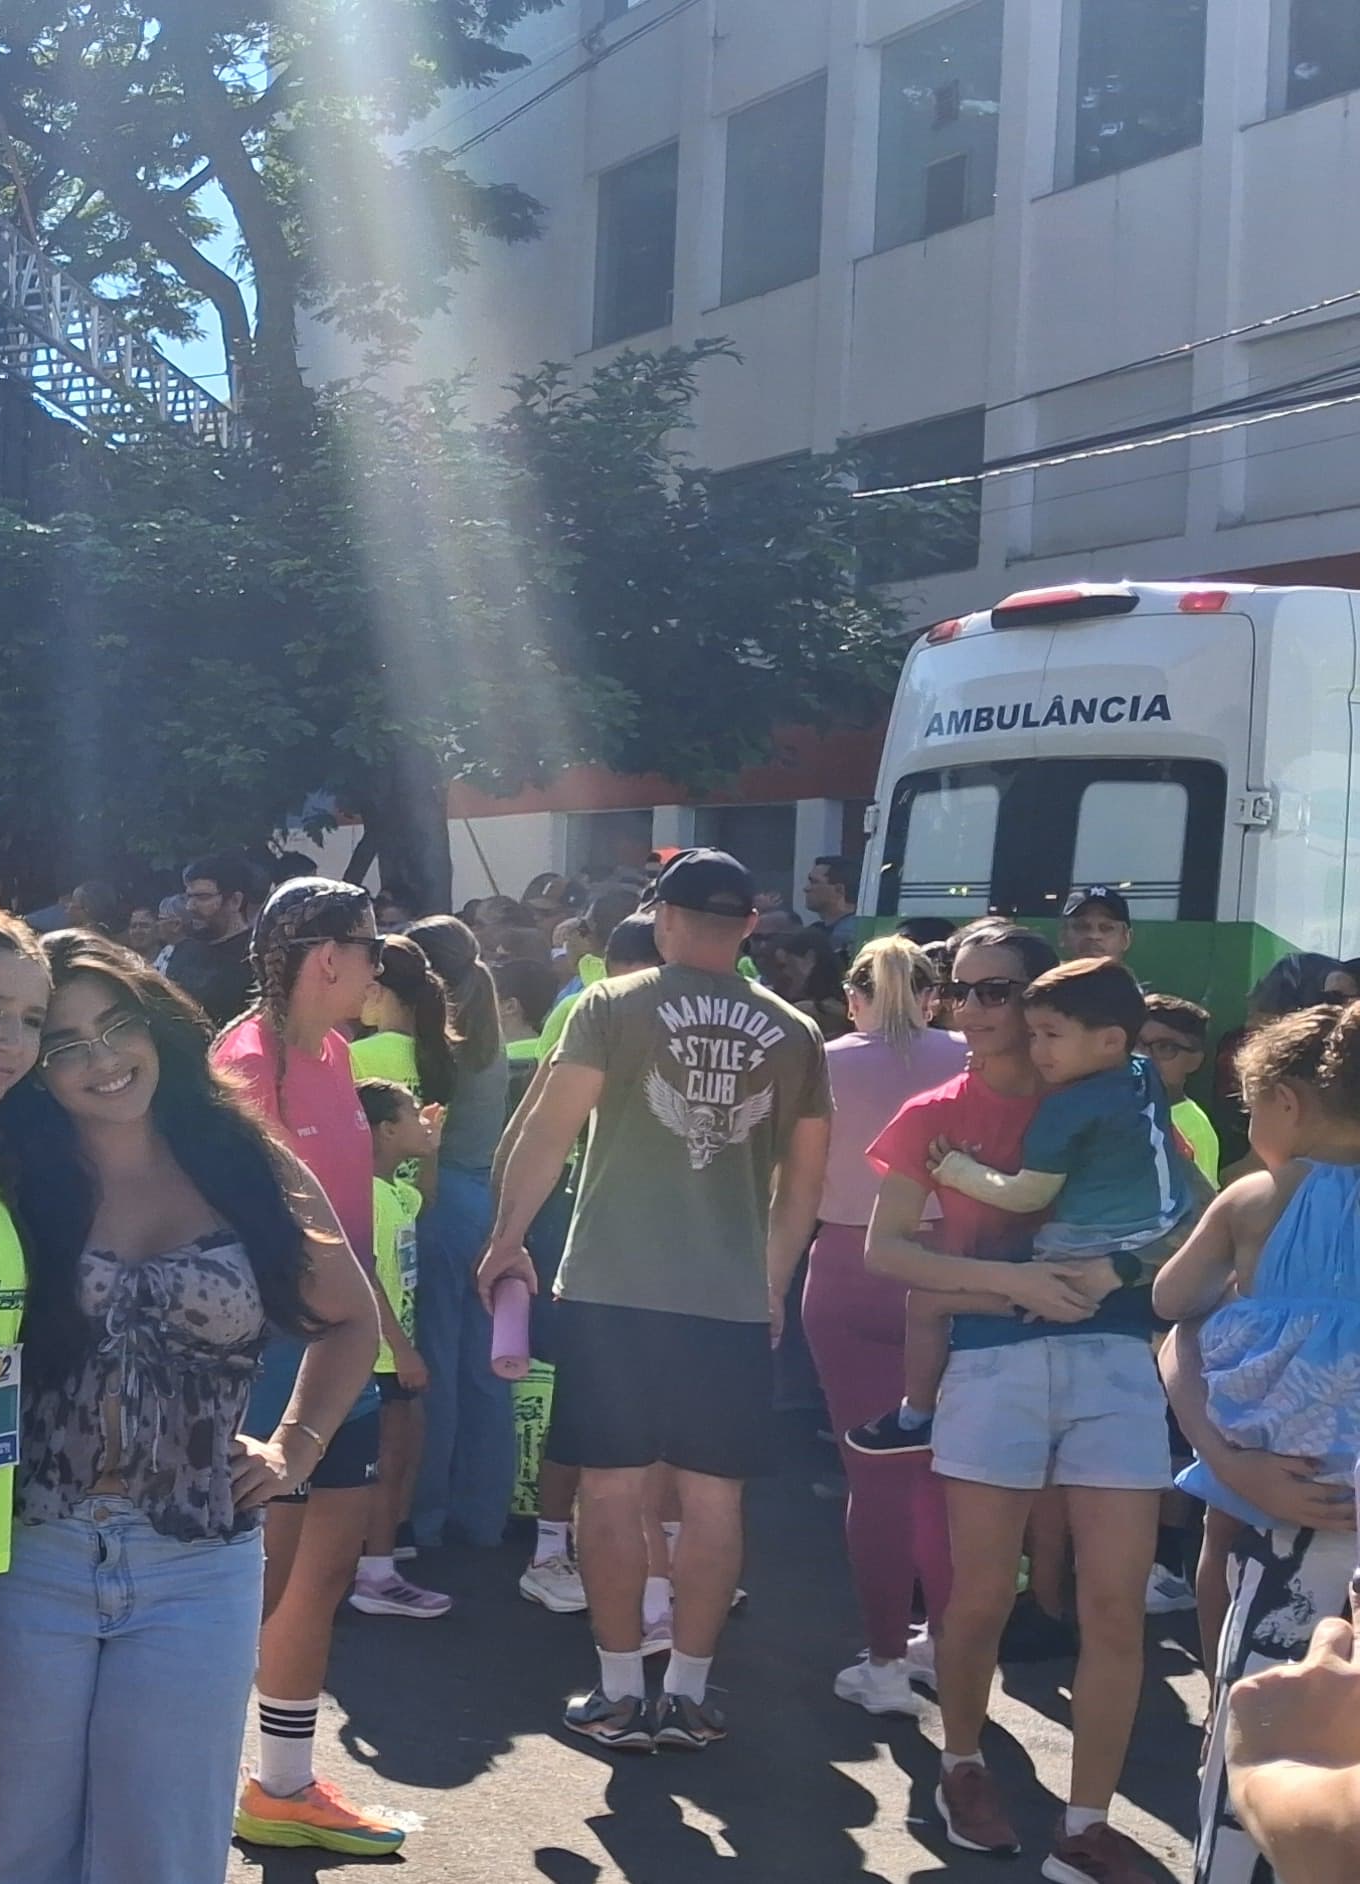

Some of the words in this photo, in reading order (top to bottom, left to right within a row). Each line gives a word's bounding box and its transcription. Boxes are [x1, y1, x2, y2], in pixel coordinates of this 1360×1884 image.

[924, 694, 1172, 738] AMBULÂNCIA
[657, 995, 786, 1049] MANHOOD
[685, 1035, 746, 1071] STYLE
[686, 1070, 737, 1105] CLUB
